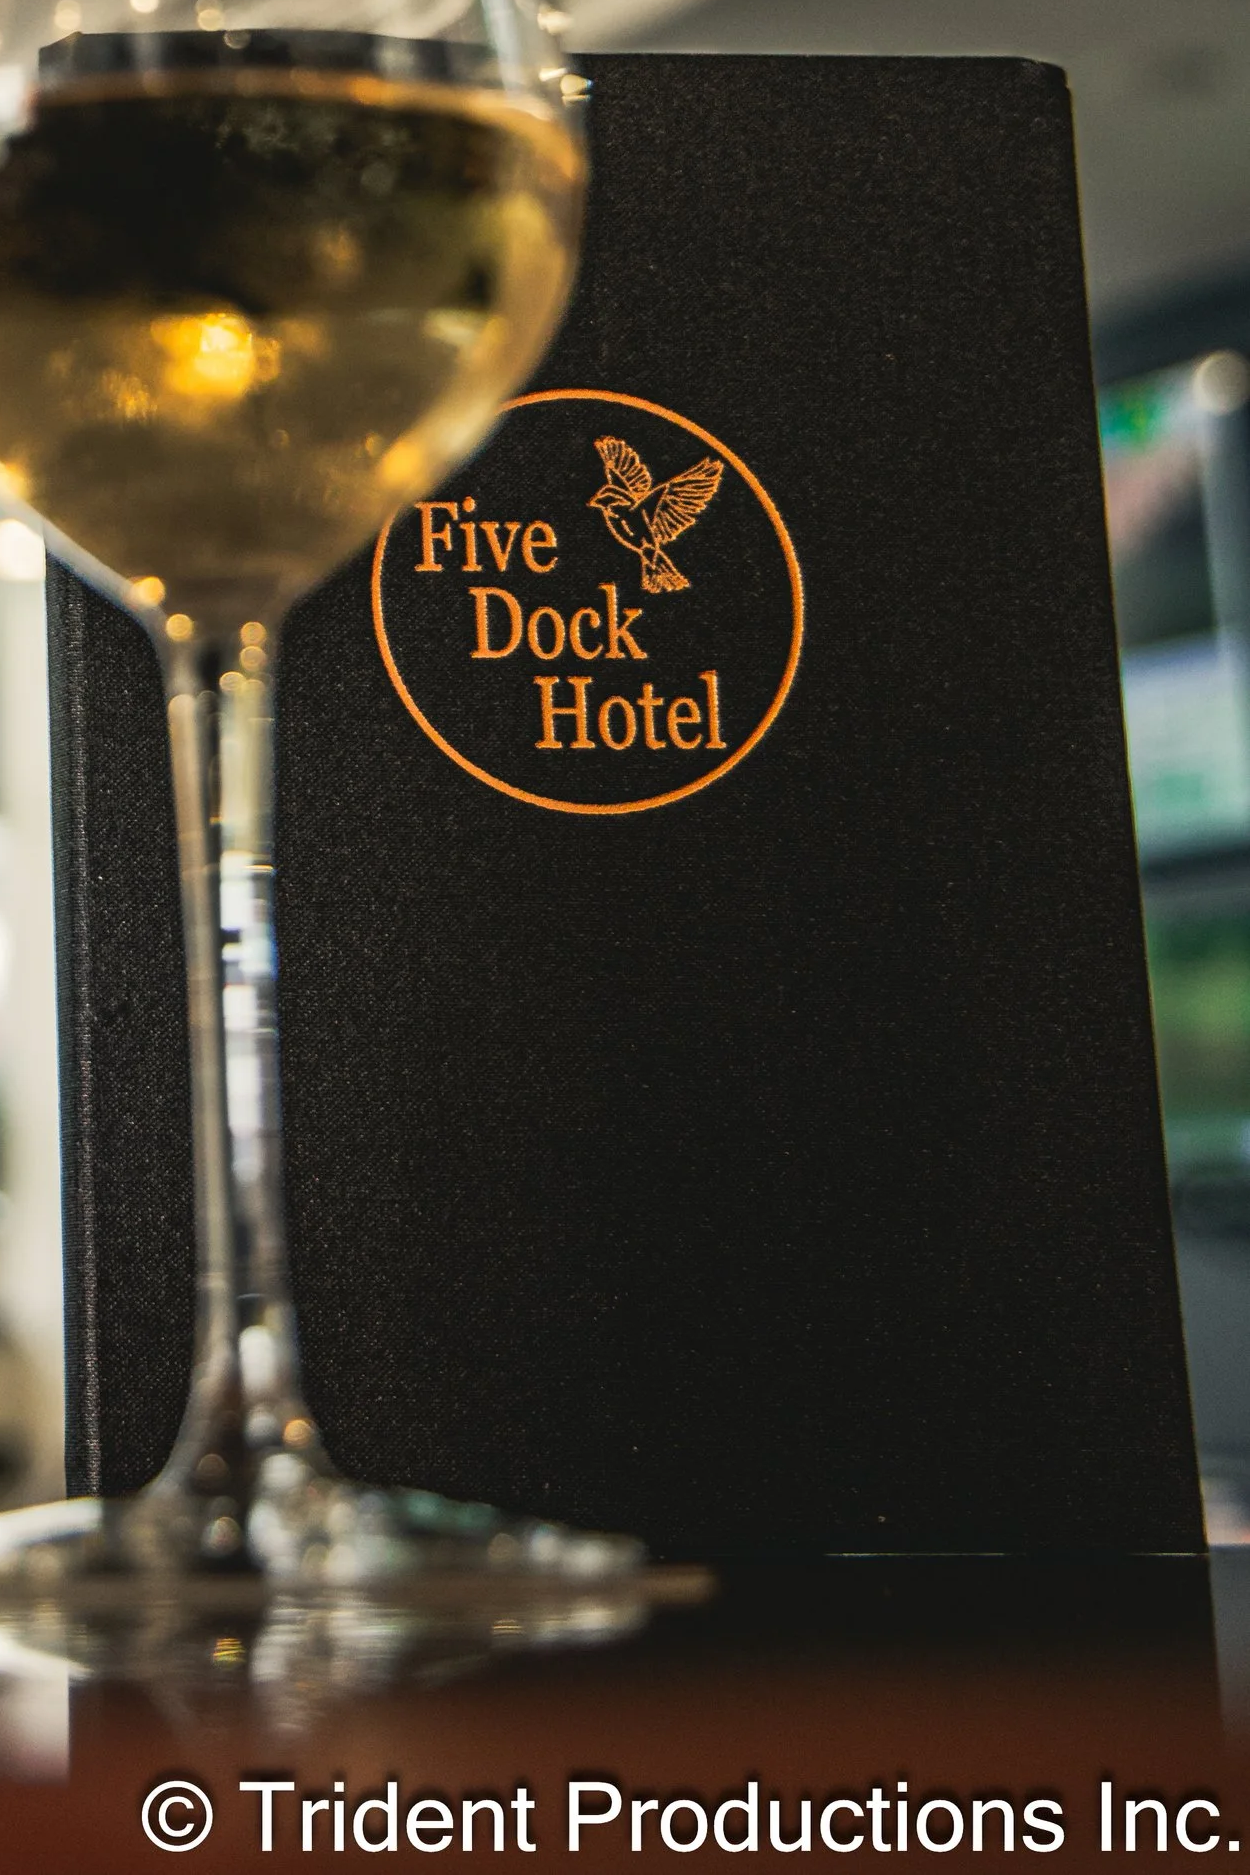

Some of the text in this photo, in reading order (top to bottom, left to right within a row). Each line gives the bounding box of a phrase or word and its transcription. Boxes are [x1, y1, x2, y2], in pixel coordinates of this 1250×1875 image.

[414, 495, 559, 574] Five
[467, 582, 648, 661] Dock
[533, 669, 727, 751] Hotel
